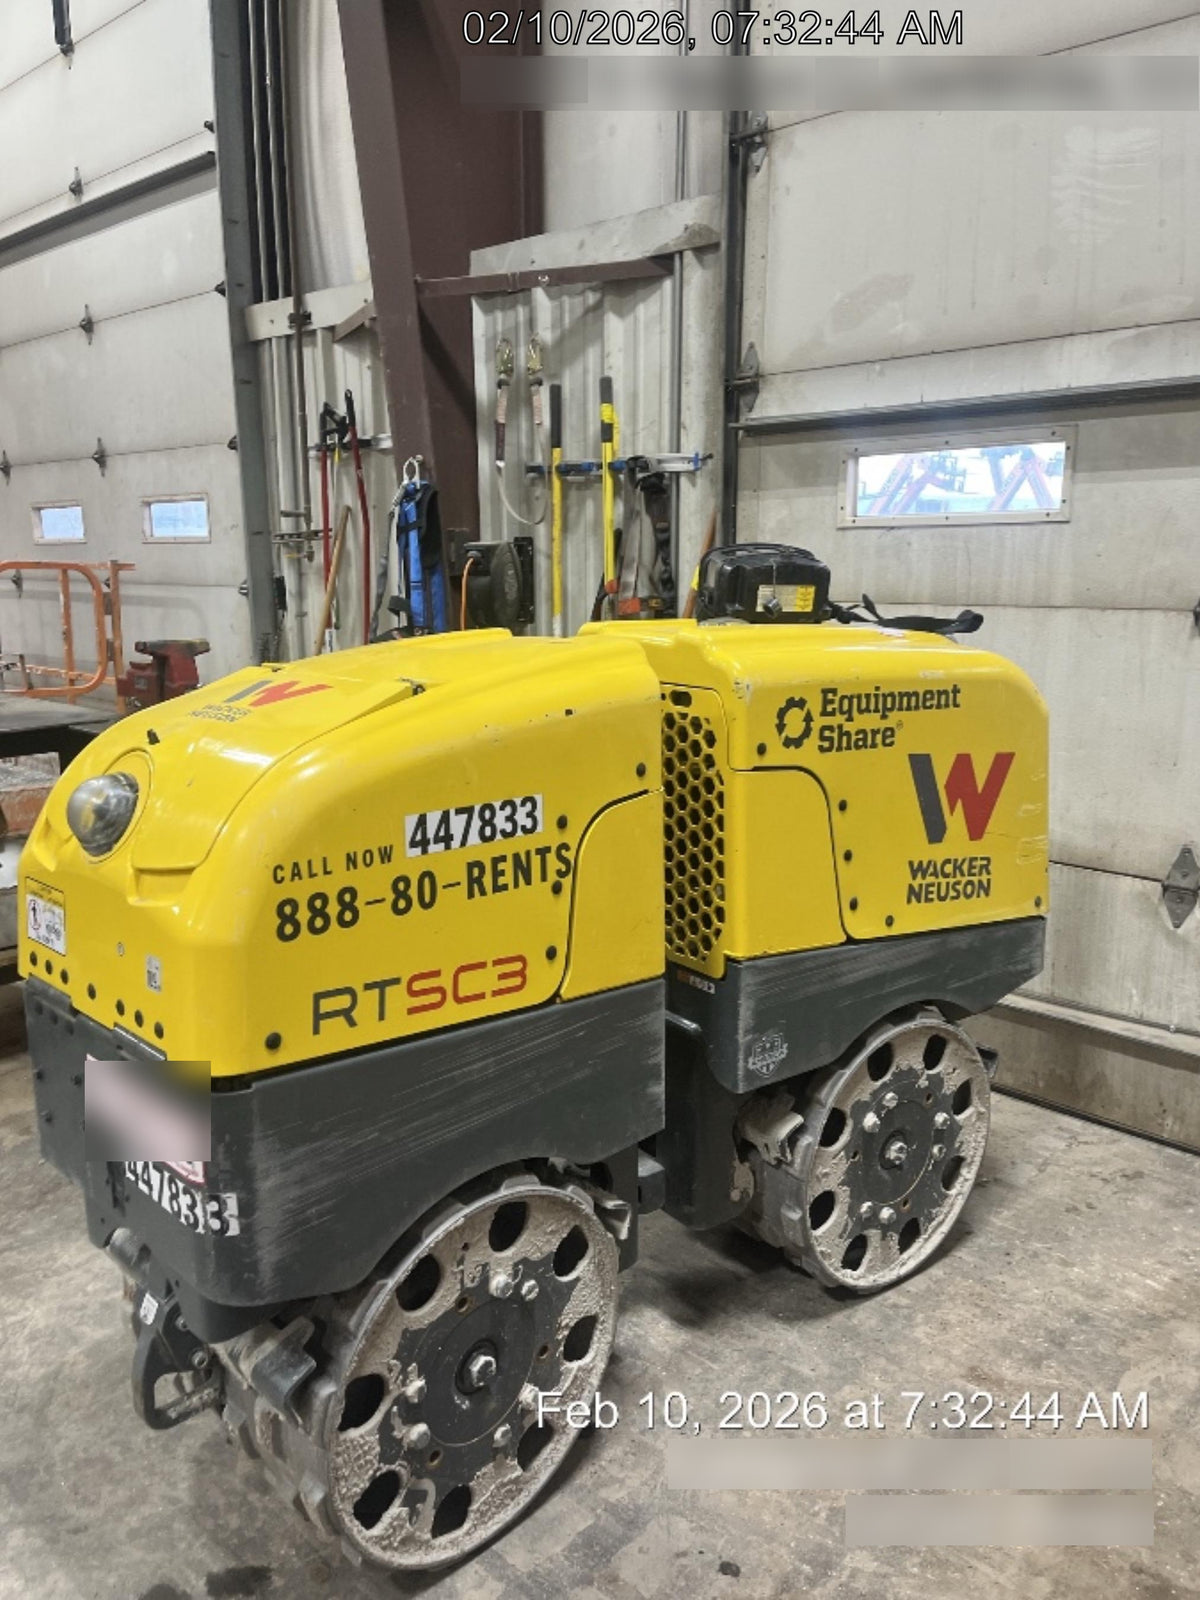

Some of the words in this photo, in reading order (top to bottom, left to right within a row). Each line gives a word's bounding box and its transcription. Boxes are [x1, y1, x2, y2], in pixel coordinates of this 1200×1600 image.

[819, 684, 961, 722] Equipment
[408, 795, 539, 856] 447833
[272, 856, 333, 885] CALL
[345, 844, 394, 872] NOW
[907, 856, 992, 881] WACKER
[275, 841, 572, 943] 888-80-RENTS
[906, 878, 991, 905] NEUSON
[311, 954, 528, 1036] RTSC3
